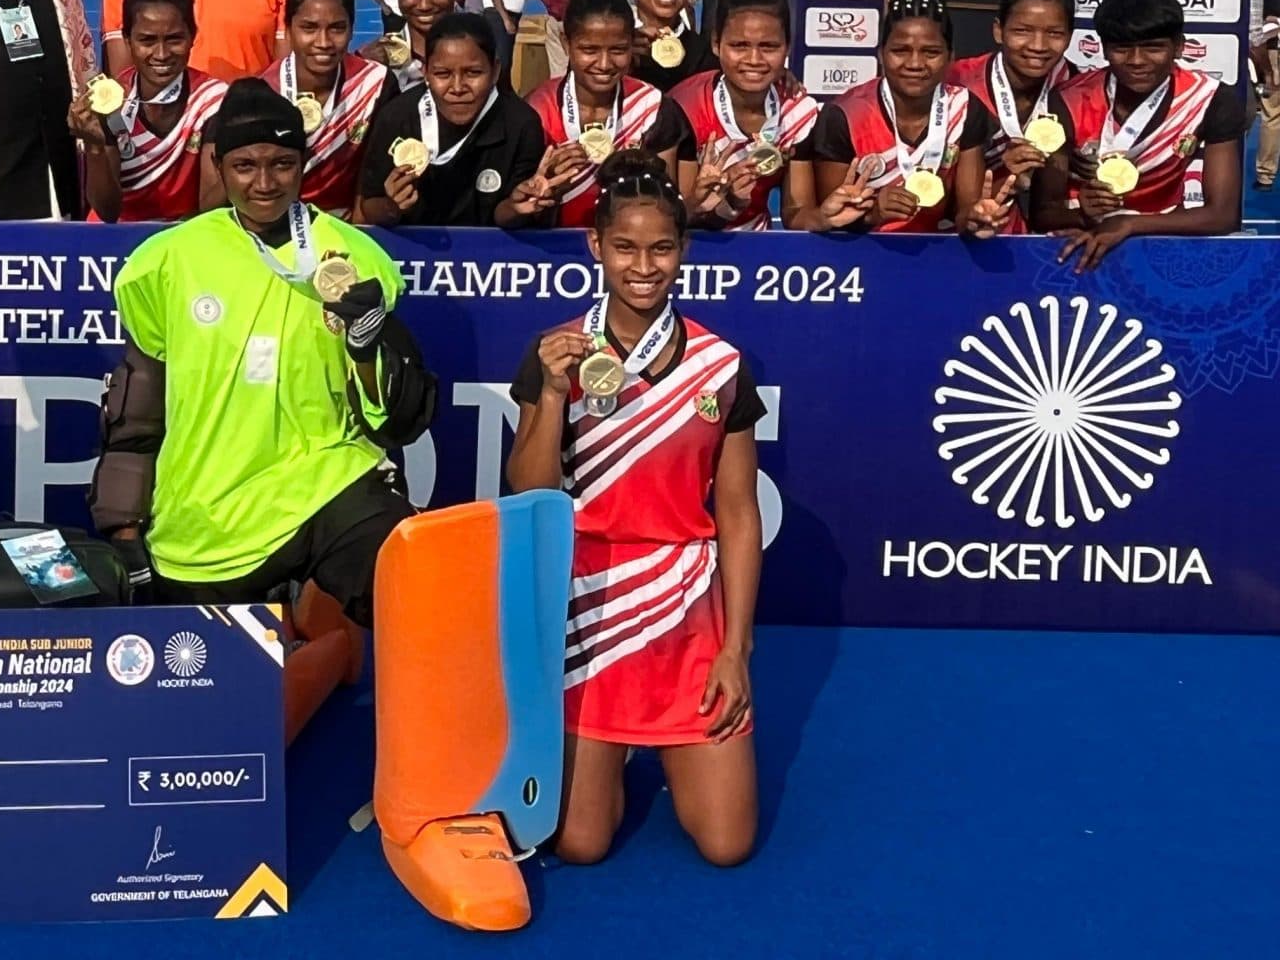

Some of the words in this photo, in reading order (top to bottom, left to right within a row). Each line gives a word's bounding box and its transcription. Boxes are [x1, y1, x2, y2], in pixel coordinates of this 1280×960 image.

[754, 265, 864, 302] 2024
[883, 540, 1070, 581] HOCKEY
[1083, 545, 1213, 586] INDIA
[0, 639, 28, 651] INDIA
[31, 639, 51, 650] SUB
[53, 638, 93, 650] JUNIOR
[8, 652, 92, 676] National
[39, 678, 73, 693] 2024
[157, 679, 189, 688] HOCKEY
[191, 678, 214, 688] INDIA
[138, 770, 151, 791] ₹
[160, 768, 250, 790] 3,00,000/-
[91, 892, 155, 902] GOVERNMENT
[157, 890, 170, 901] OF
[173, 888, 228, 900] TELANGANA
